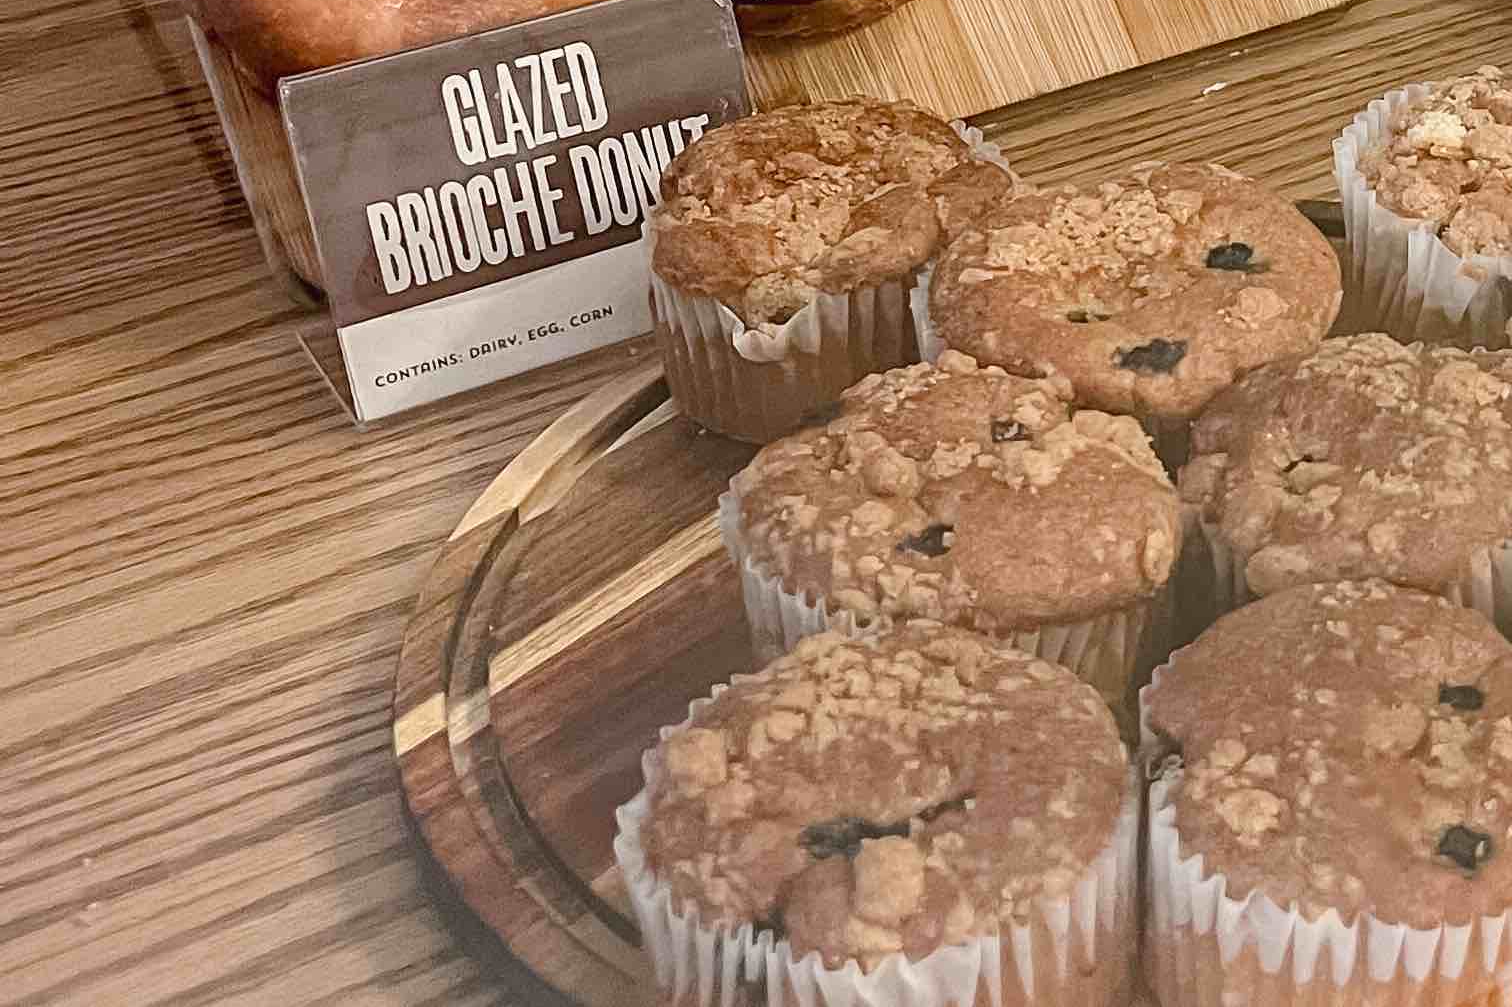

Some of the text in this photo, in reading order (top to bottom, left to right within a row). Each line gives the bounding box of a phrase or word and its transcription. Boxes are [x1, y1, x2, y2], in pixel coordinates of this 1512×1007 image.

[441, 41, 609, 166] GLAZED
[366, 154, 575, 294] BRIOCHE
[375, 353, 464, 387] CONTAINS:
[570, 305, 613, 327] CORN
